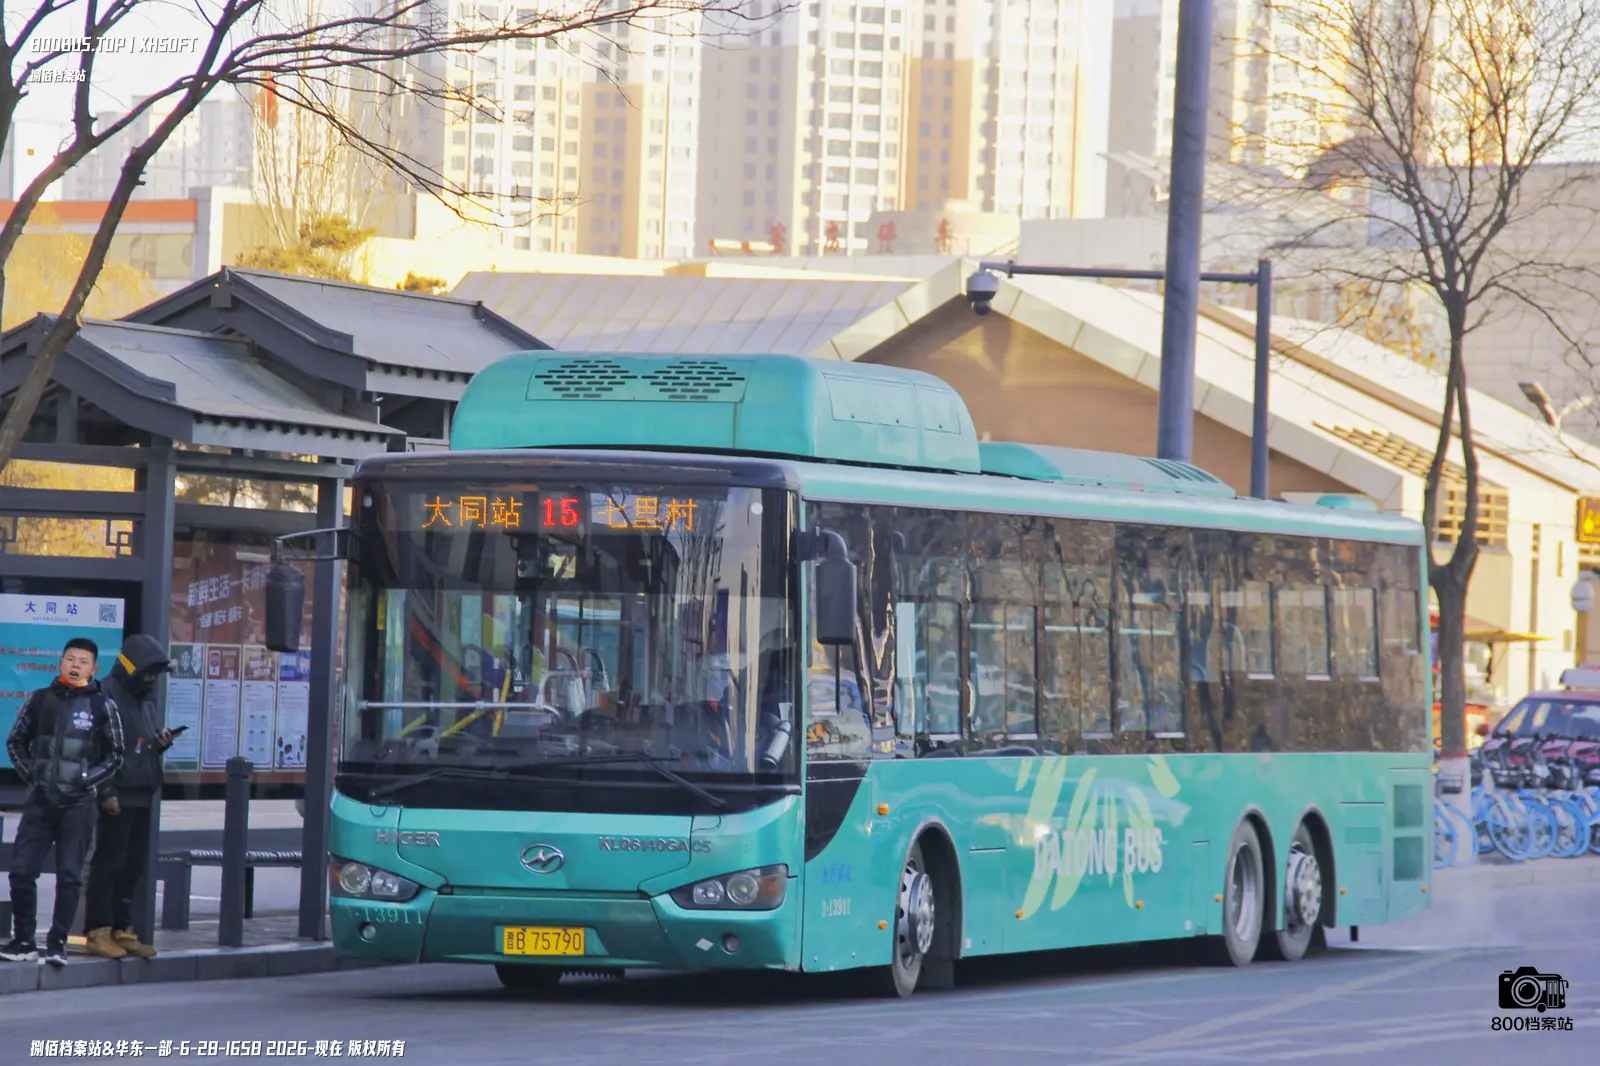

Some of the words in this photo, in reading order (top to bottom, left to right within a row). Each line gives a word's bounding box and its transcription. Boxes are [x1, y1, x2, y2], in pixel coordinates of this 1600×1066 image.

[422, 496, 523, 528] 大同站
[543, 497, 579, 527] 15
[597, 497, 698, 530] 七里村
[25, 601, 79, 615] 大同站
[375, 829, 441, 847] HIGER
[1033, 827, 1118, 879] DATONG
[1123, 826, 1164, 874] BUS
